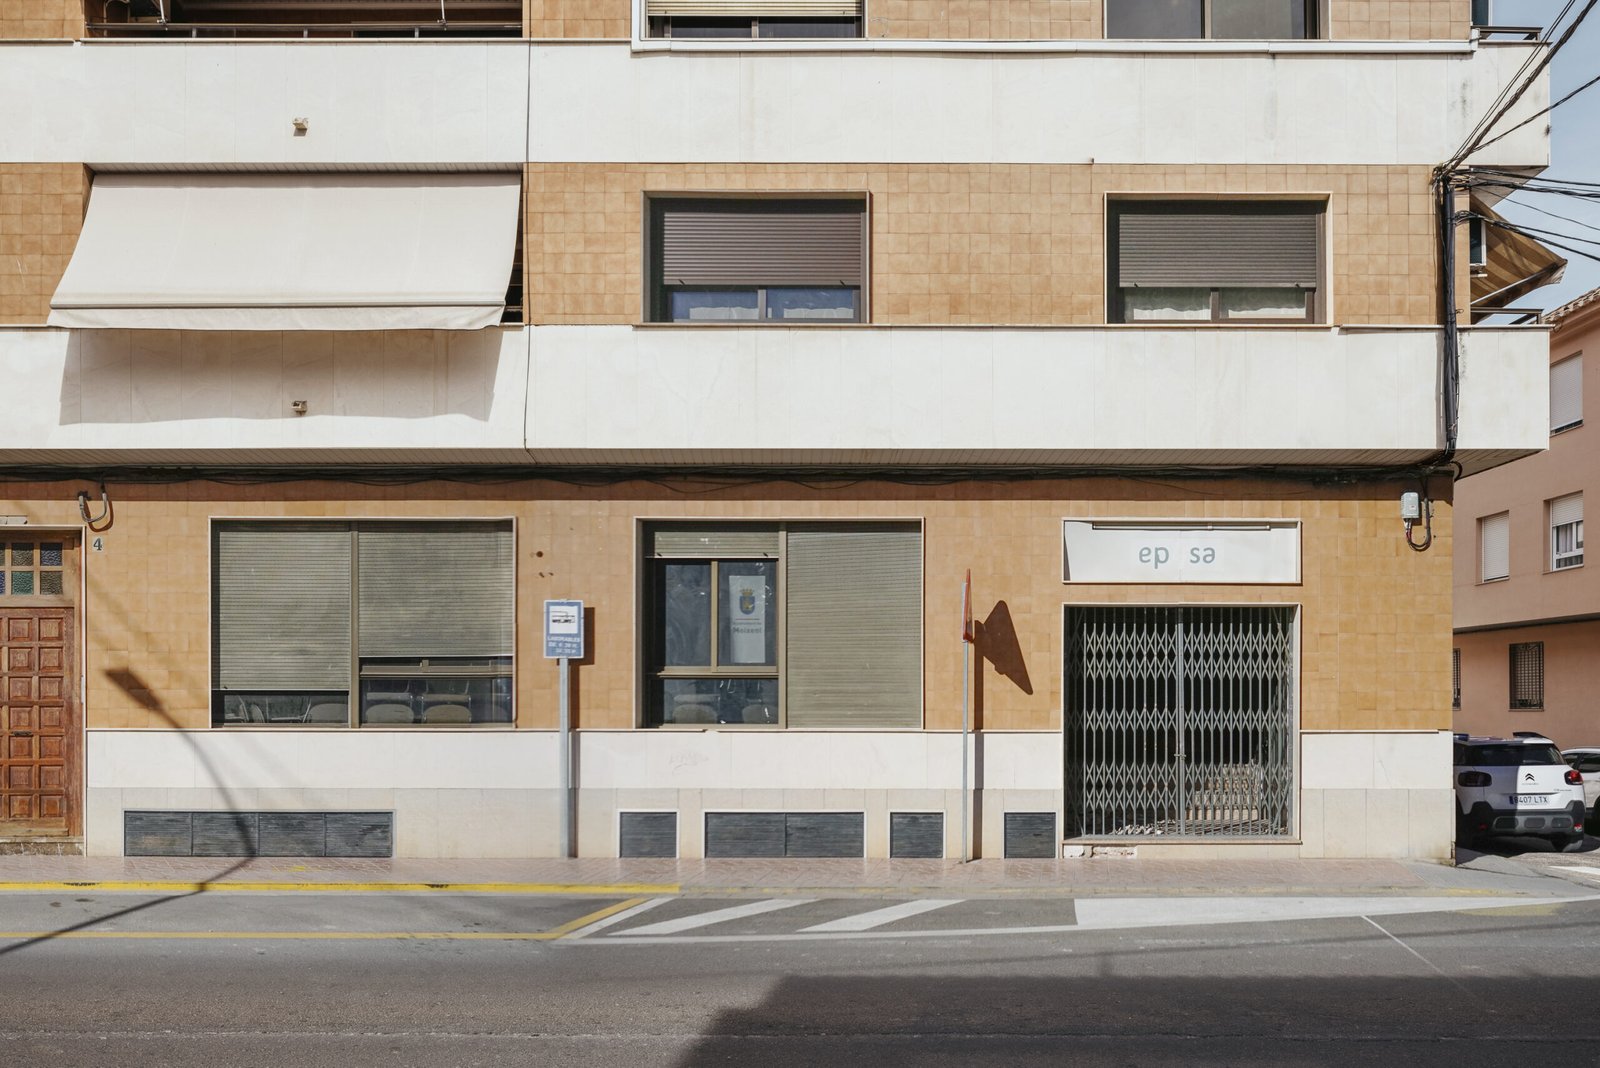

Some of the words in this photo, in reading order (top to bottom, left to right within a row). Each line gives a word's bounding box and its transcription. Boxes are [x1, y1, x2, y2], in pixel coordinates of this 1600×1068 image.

[93, 537, 103, 551] 4
[1139, 546, 1169, 570] ep
[1534, 795, 1548, 804] LTX
